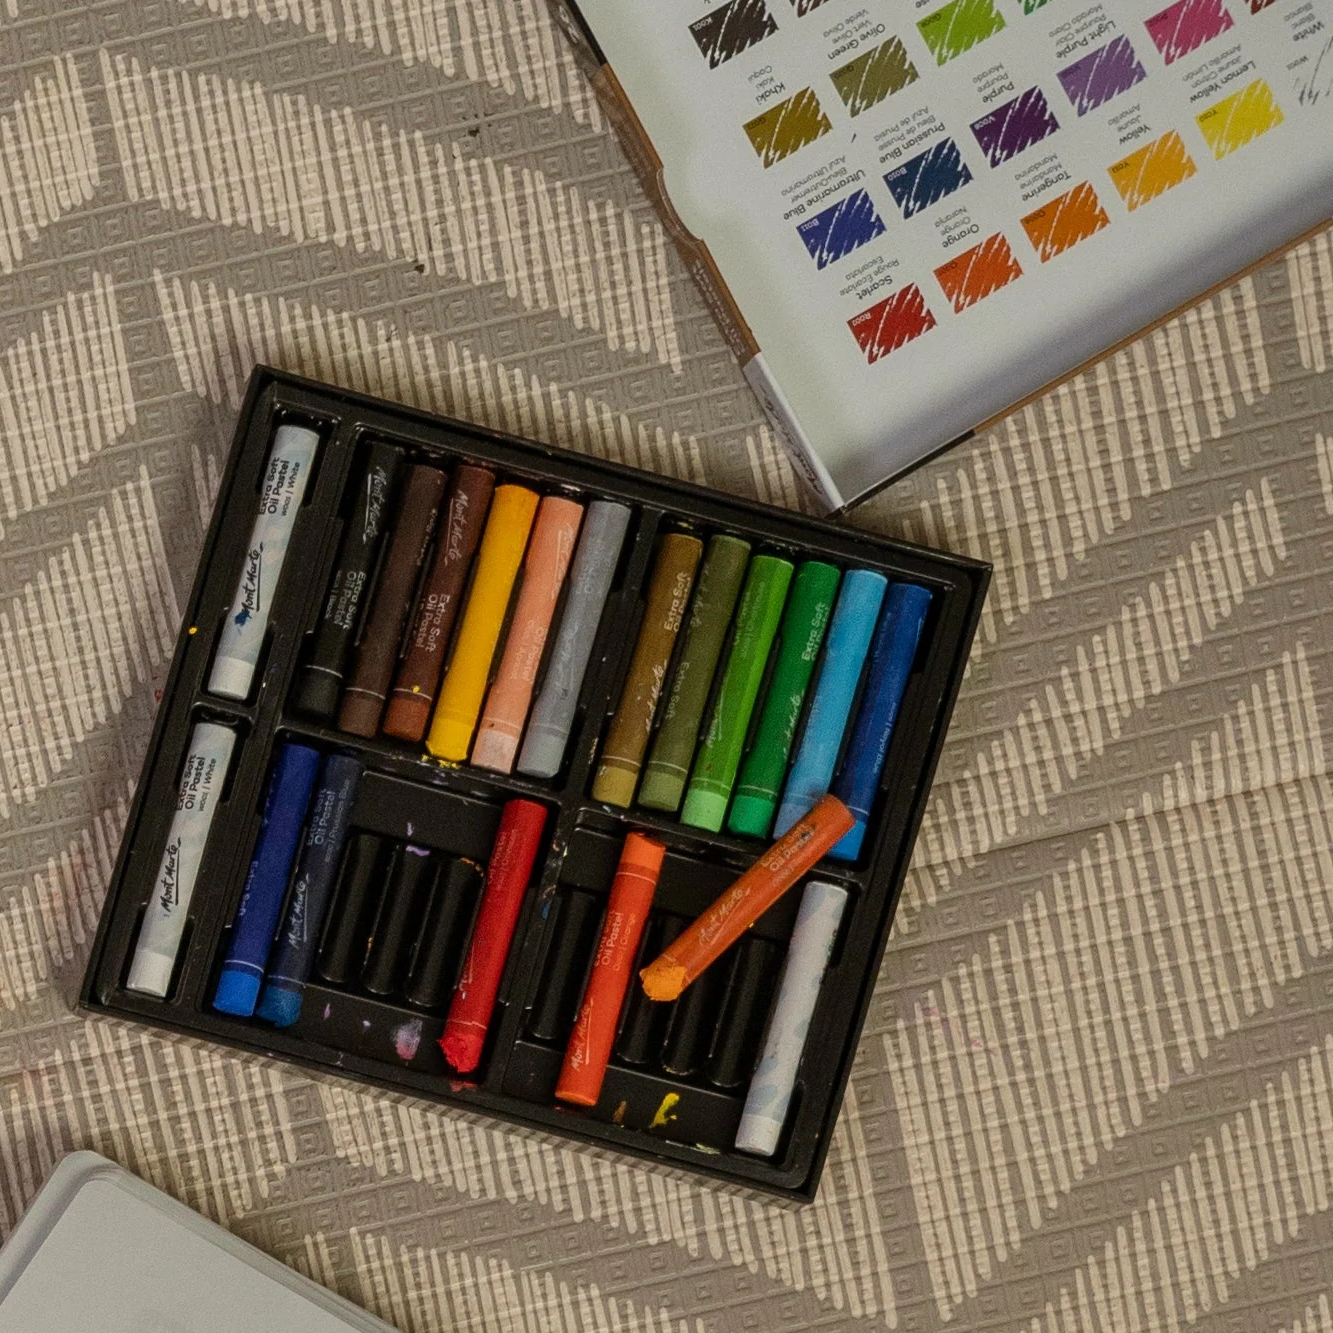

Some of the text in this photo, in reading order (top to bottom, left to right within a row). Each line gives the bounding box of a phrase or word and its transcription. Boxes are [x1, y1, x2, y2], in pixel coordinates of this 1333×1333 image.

[826, 21, 886, 62] Olive Green
[1054, 34, 1088, 60] Purple
[1086, 18, 1116, 41] Light
[1291, 19, 1324, 44] White
[754, 81, 786, 105] Khaki
[980, 79, 1014, 105] Purple
[1187, 59, 1256, 105] Lemon Yellow
[878, 120, 945, 165] Prussian Blue
[1117, 122, 1150, 146] Yellow
[781, 167, 866, 222] Ultramarine Blue
[1020, 167, 1070, 203] Tangerine
[940, 221, 980, 250] Orange
[855, 273, 894, 302] Scarlet
[257, 455, 280, 515] Extra Soft
[266, 459, 289, 515] Oil Pastel
[287, 461, 300, 488] White
[241, 547, 264, 584] Marte
[332, 587, 352, 625] Pastel
[425, 592, 437, 610] Oil
[663, 570, 687, 631] Extra Soft
[423, 592, 450, 654] Extra Soft
[174, 753, 196, 811] Extra Soft
[184, 755, 206, 810] Oil Pastel
[203, 757, 217, 784] White
[318, 789, 336, 826] Pastel
[313, 826, 327, 845] Oil
[154, 842, 181, 912] Mont Marte
[600, 948, 612, 966] Oil
[606, 911, 623, 947] Pastel
